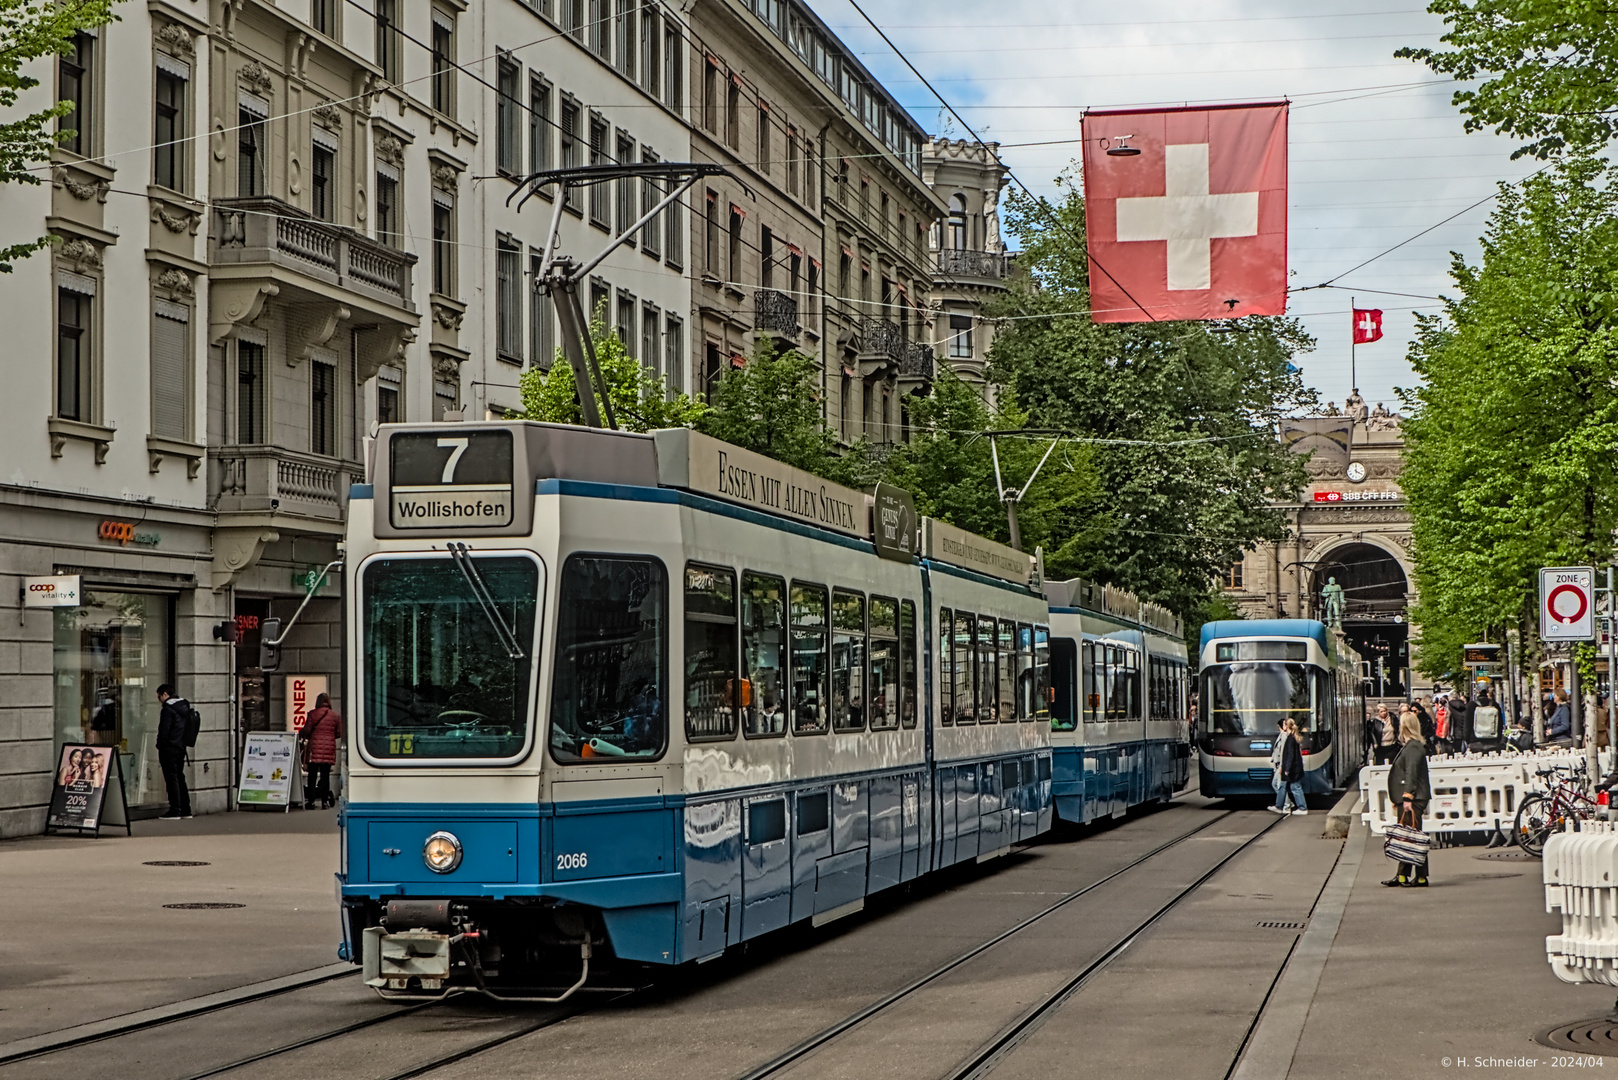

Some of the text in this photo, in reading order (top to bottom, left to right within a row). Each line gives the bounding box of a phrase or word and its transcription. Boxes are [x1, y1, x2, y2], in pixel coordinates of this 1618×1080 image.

[437, 437, 469, 483] 7
[760, 475, 781, 508] MIT
[784, 483, 817, 519] ALLEN
[1342, 491, 1398, 501] SBB CFF FFS
[398, 500, 505, 518] Wollishofen
[101, 521, 134, 546] coop
[1556, 574, 1579, 583] ZONE
[29, 584, 55, 592] coop
[66, 795, 87, 805] 20%
[557, 852, 588, 870] 2066
